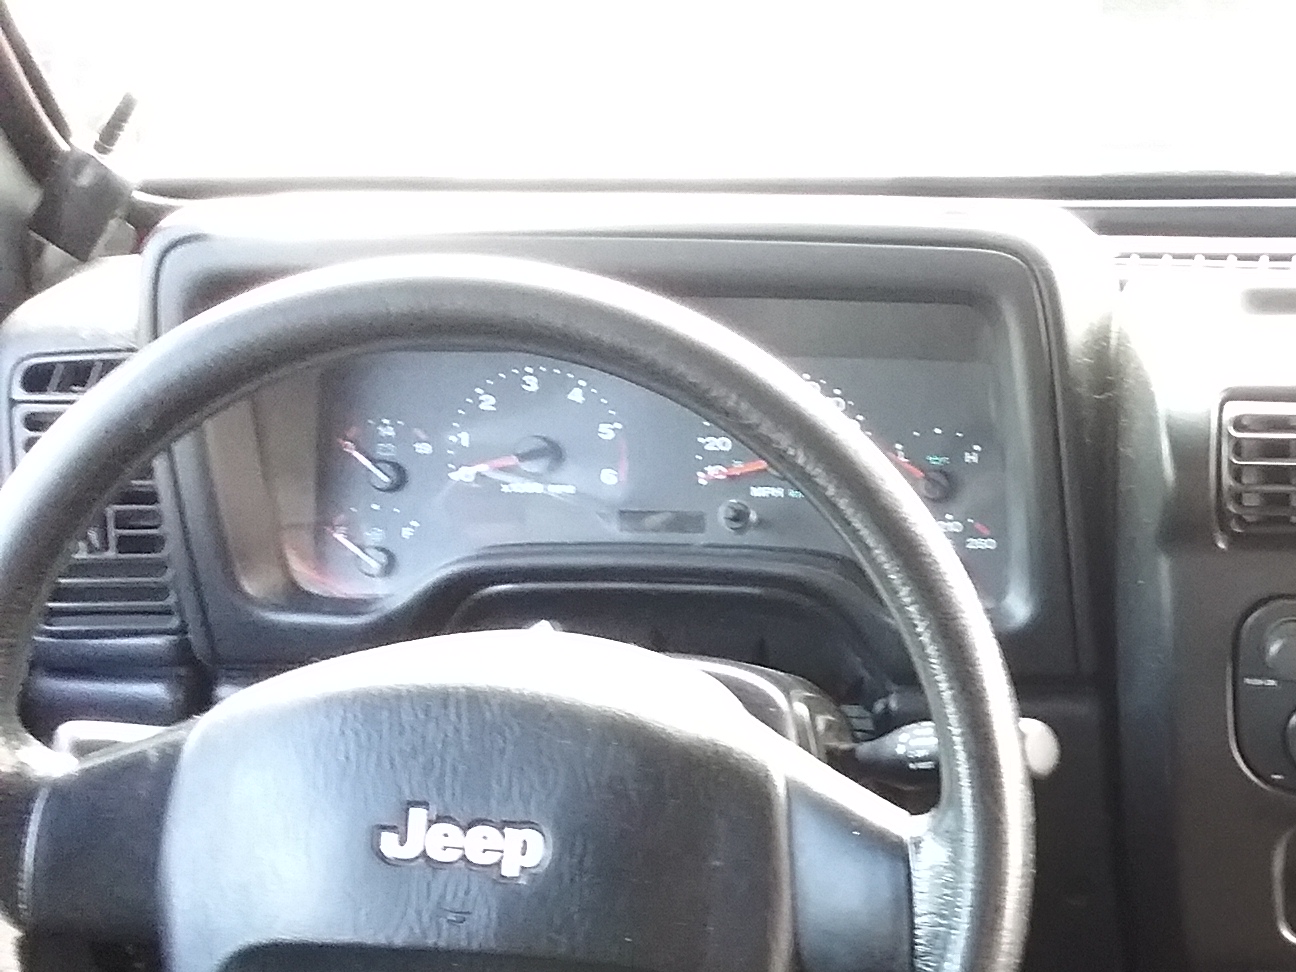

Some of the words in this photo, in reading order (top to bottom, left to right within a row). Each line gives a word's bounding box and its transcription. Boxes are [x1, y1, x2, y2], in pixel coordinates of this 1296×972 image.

[522, 375, 539, 392] 3
[478, 394, 497, 411] 2
[567, 387, 585, 403] 4
[457, 431, 470, 447] 1
[598, 423, 616, 440] 5
[704, 437, 732, 451] 20
[600, 468, 618, 485] 6
[376, 802, 547, 879] Jeep
